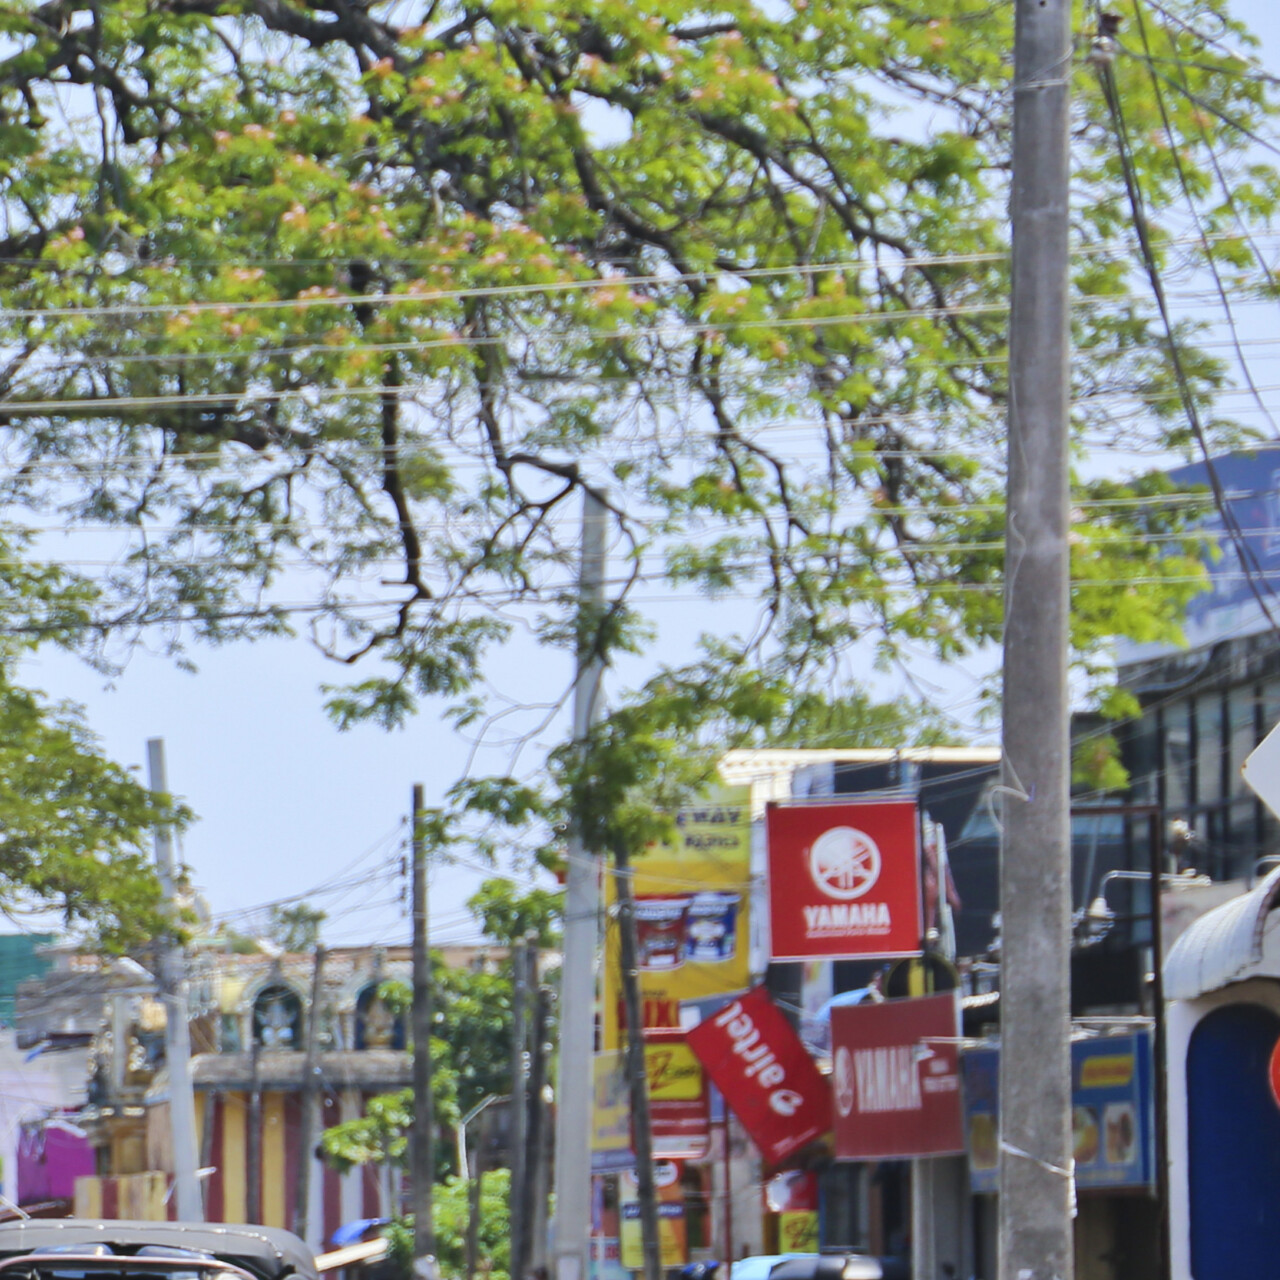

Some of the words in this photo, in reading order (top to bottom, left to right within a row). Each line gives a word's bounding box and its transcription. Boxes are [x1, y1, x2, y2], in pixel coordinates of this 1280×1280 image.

[803, 902, 891, 929] YAMAHA
[714, 1001, 786, 1089] airtel
[853, 1045, 922, 1113] YAMAHA
